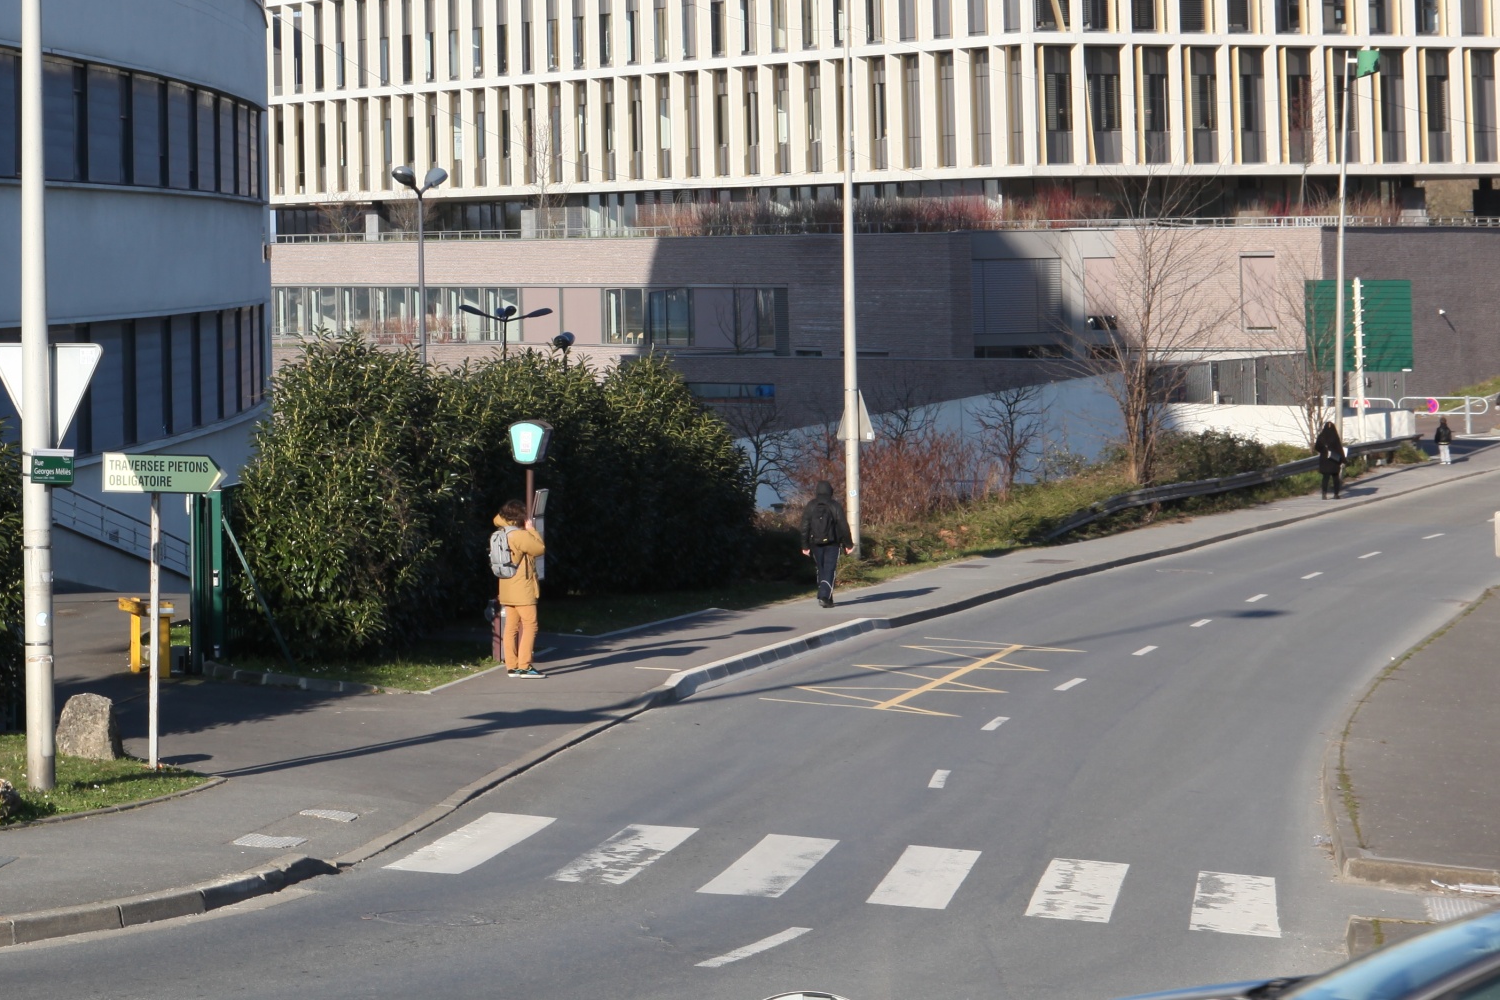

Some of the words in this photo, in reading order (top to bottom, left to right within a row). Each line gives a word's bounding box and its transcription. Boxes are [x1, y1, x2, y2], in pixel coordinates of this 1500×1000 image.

[34, 468, 54, 476] Georges
[109, 459, 165, 472] TRAVERSEE
[168, 461, 209, 473] PIETONS
[109, 474, 172, 487] OBLIGATOIRE
